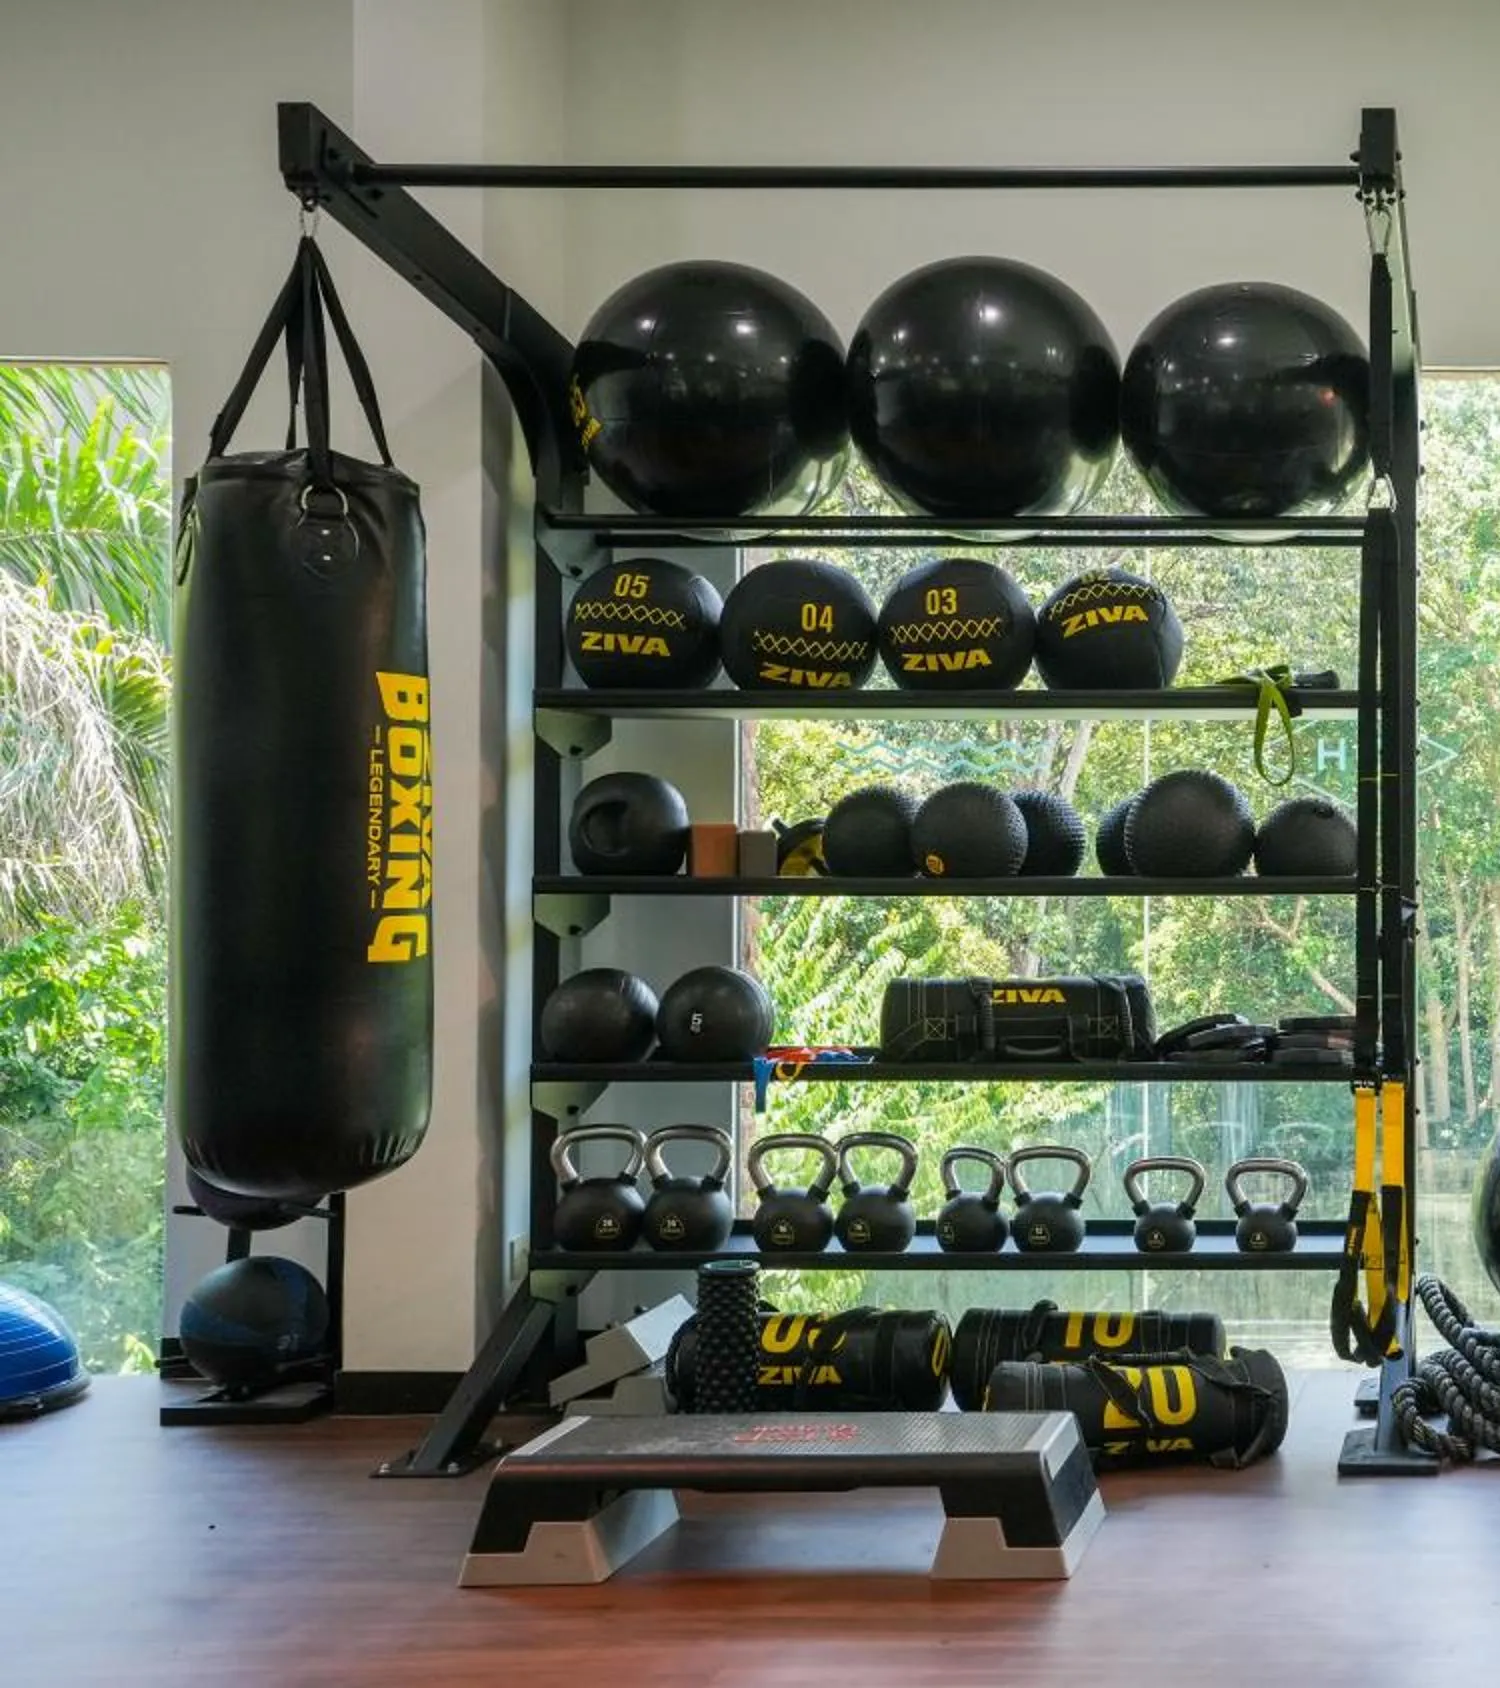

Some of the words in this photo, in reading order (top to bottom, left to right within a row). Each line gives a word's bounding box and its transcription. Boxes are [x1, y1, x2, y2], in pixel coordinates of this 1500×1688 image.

[614, 573, 650, 598] 05
[926, 587, 957, 615] 03
[801, 603, 834, 633] 04
[1061, 605, 1149, 639] ZIVA
[581, 631, 671, 656] ZIVA
[901, 648, 993, 671] ZIVA
[760, 661, 852, 688] ZIVA
[367, 671, 429, 963] BOXING
[367, 749, 385, 887] LEGENDARY
[991, 988, 1068, 1003] ZIVA
[761, 1310, 848, 1354] 0
[1064, 1311, 1135, 1348] 10
[1103, 1436, 1194, 1454] ZVA
